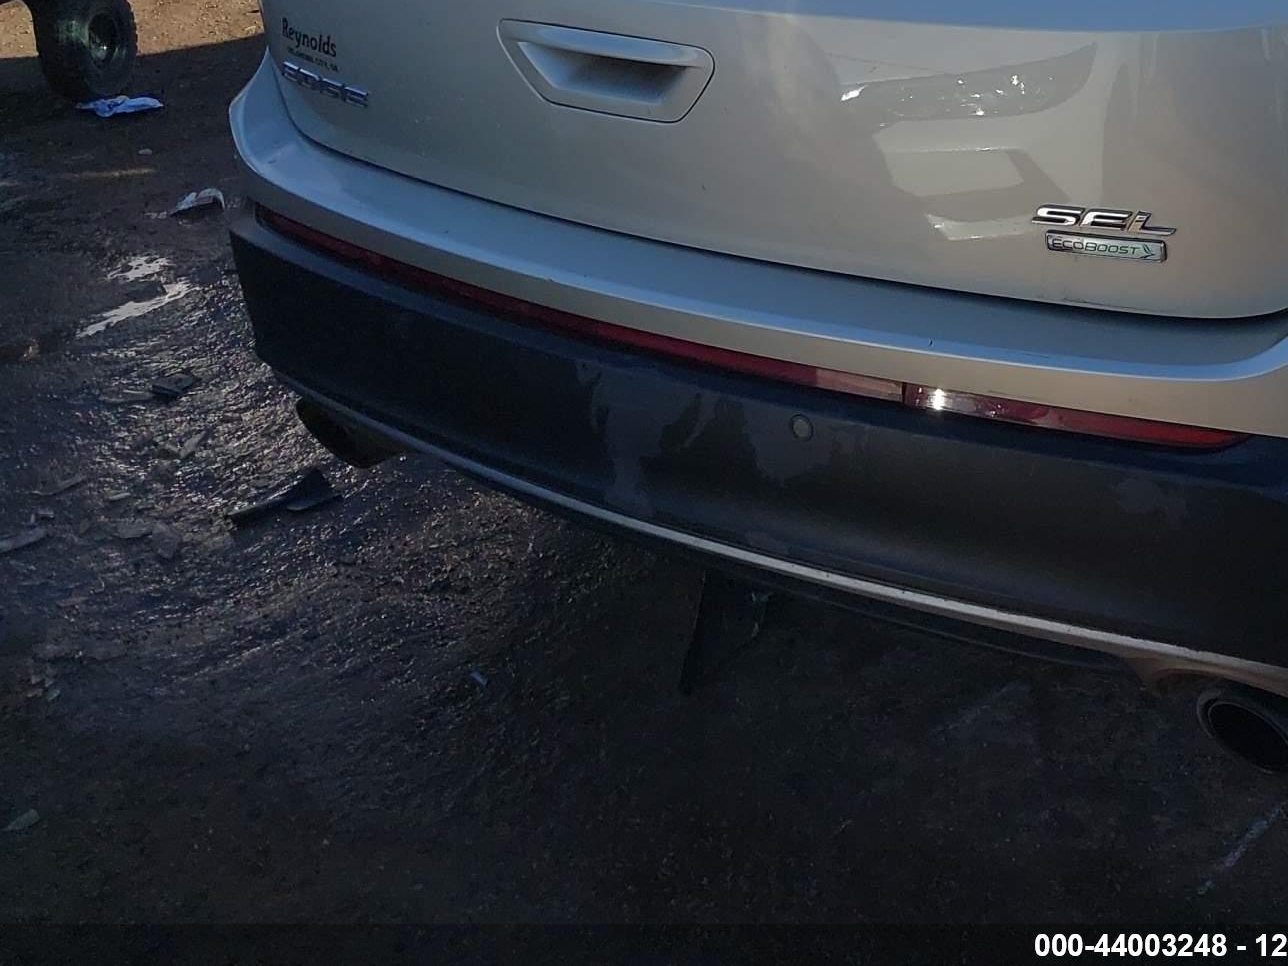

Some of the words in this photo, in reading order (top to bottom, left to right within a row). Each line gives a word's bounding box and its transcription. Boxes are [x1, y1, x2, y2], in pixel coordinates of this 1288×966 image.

[282, 17, 337, 58] Reynolds
[282, 61, 369, 108] EDGE
[1031, 203, 1178, 236] SEL
